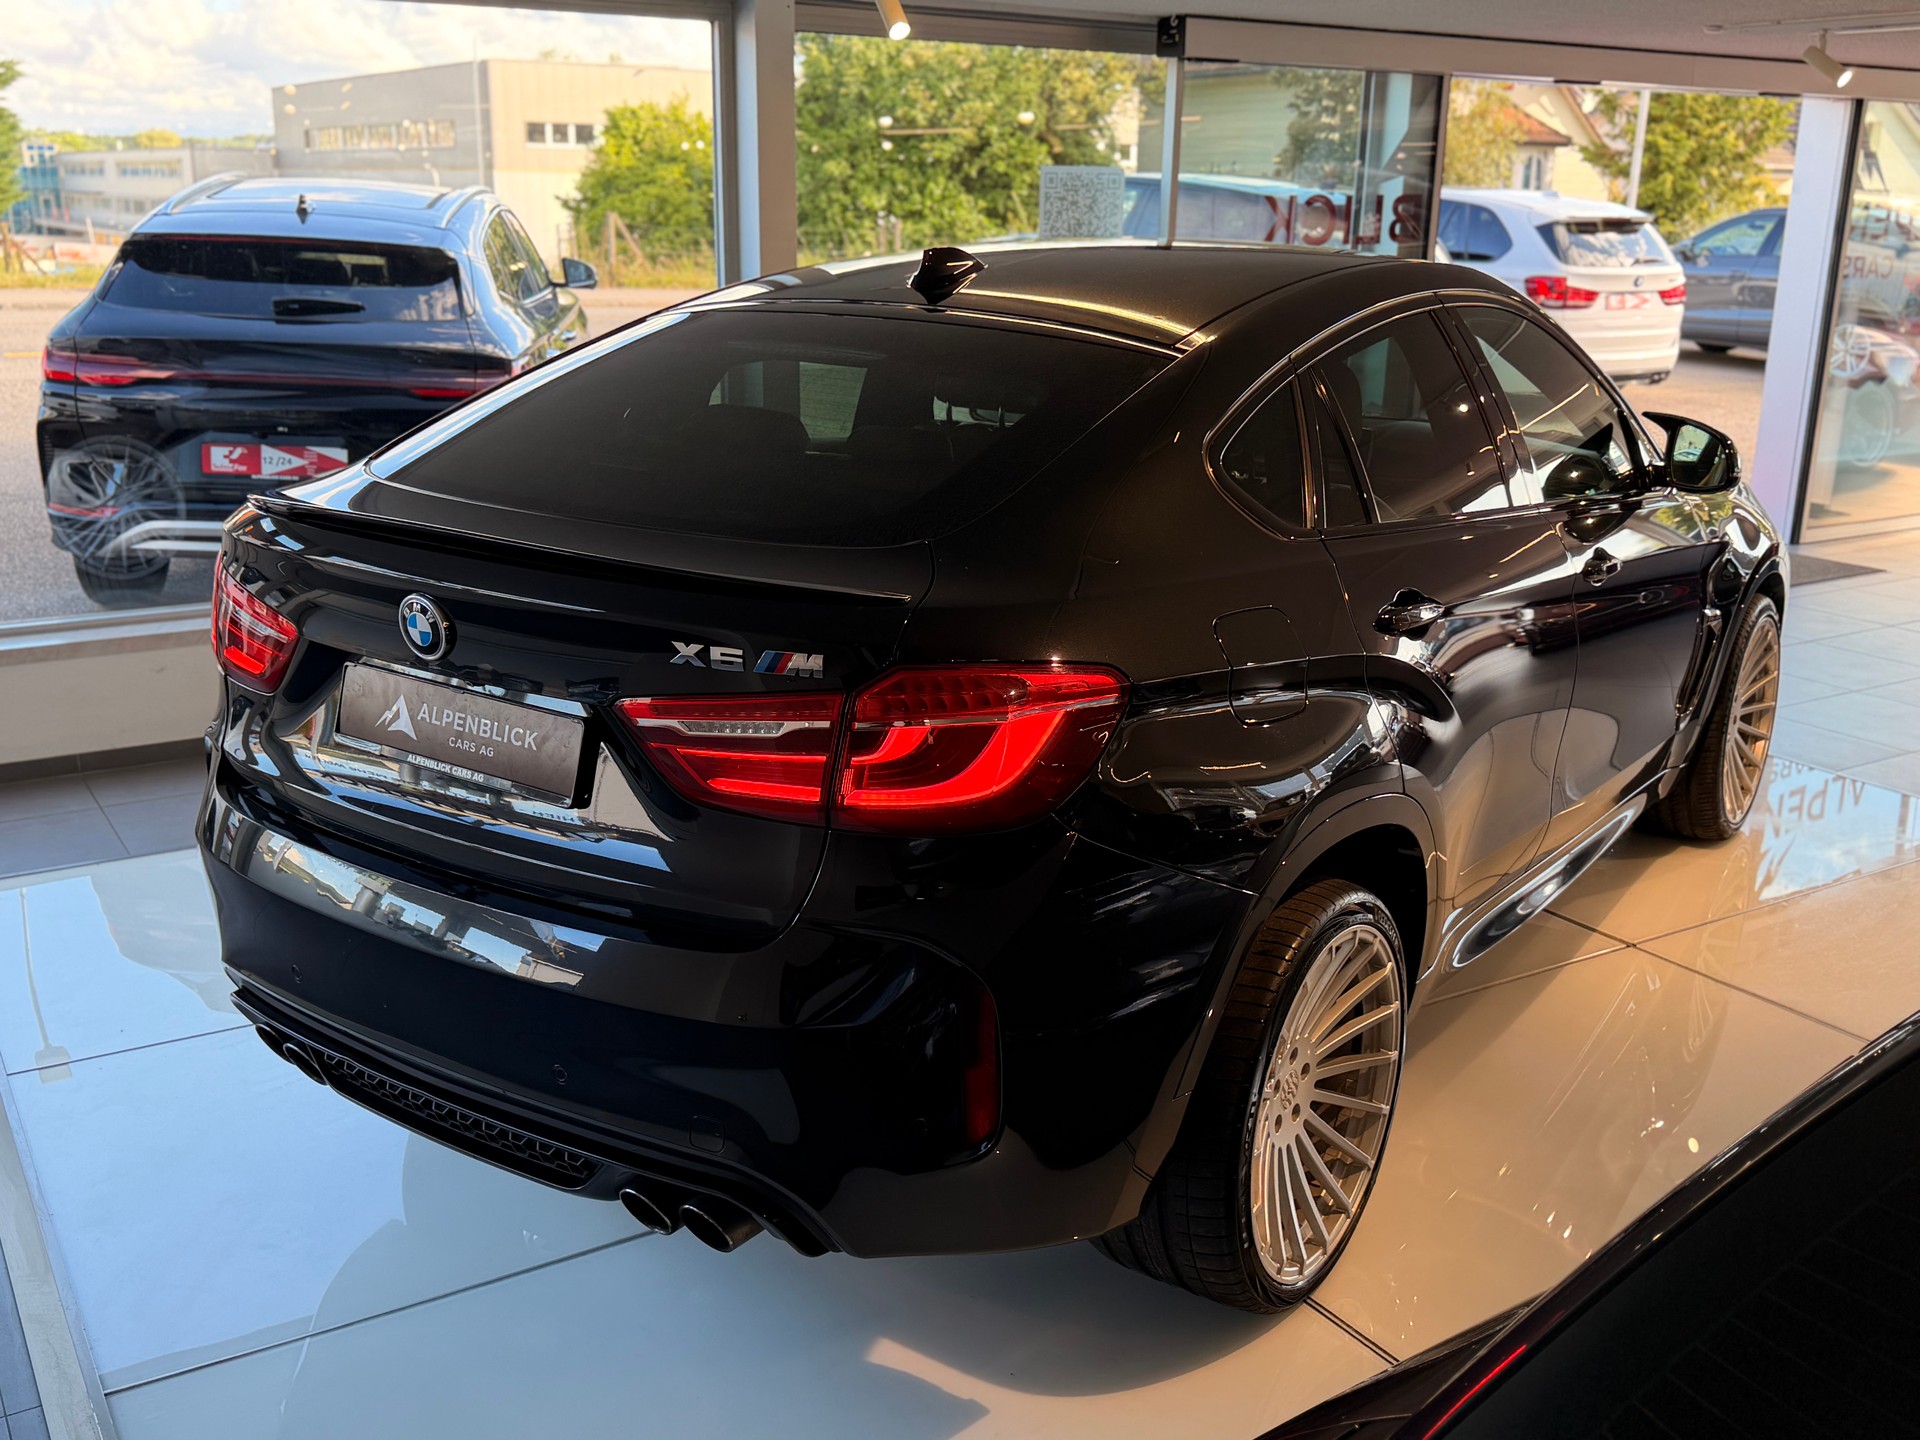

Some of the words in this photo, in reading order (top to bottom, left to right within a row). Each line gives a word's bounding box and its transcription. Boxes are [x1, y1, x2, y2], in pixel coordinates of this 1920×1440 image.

[403, 602, 435, 624] BMW
[670, 640, 744, 672] X6
[417, 702, 540, 751] ALPENBLICK
[448, 737, 476, 753] CARS
[479, 745, 495, 758] AG
[406, 754, 451, 774] ALPENBLICK
[451, 766, 472, 780] CARS
[472, 772, 485, 783] AG
